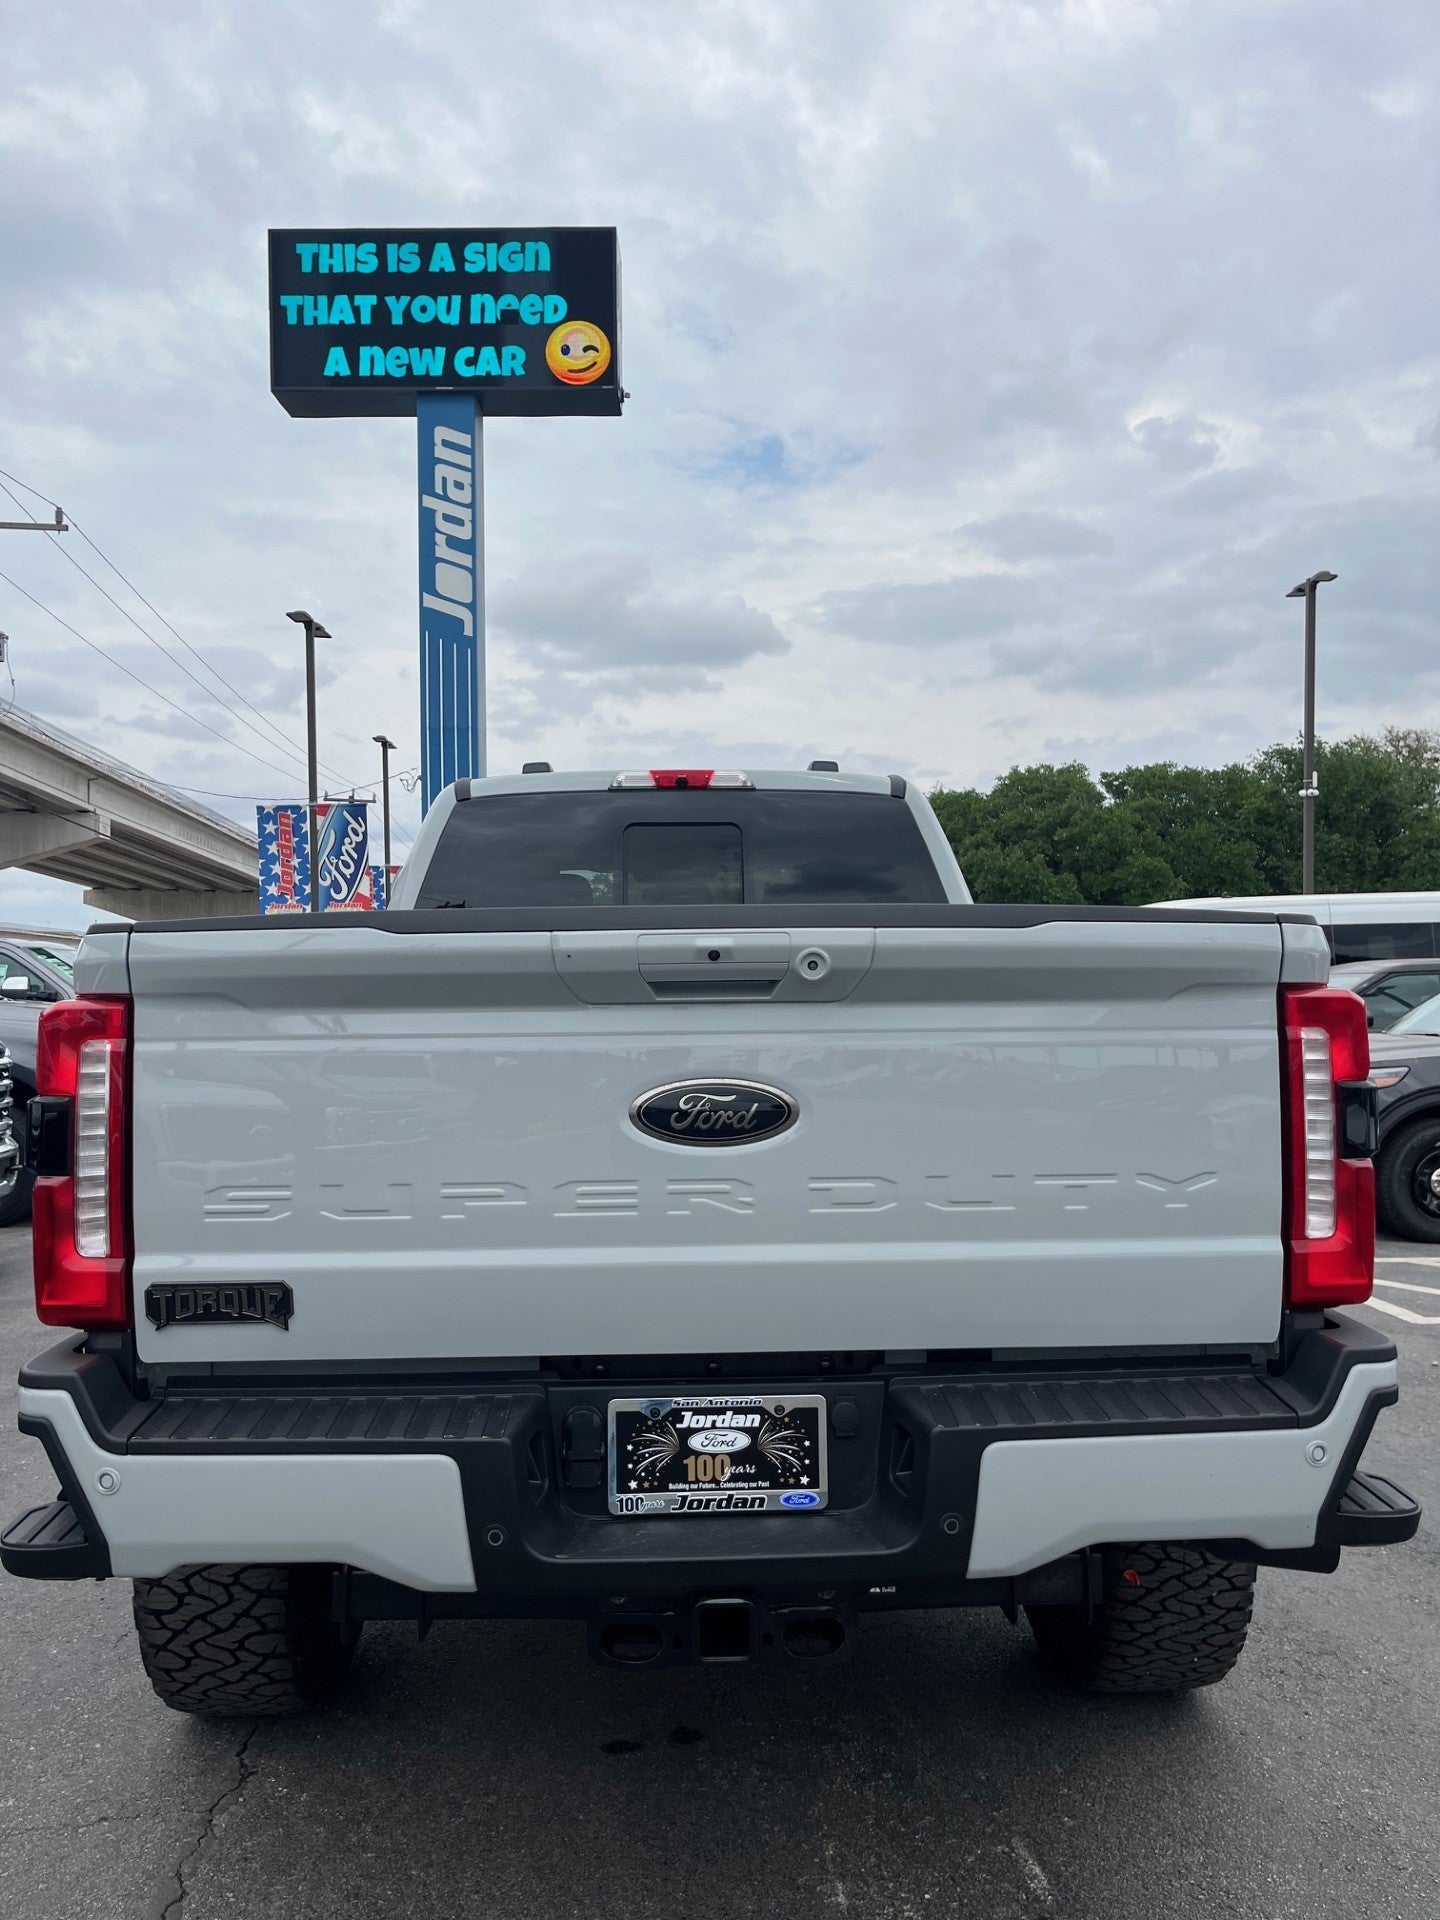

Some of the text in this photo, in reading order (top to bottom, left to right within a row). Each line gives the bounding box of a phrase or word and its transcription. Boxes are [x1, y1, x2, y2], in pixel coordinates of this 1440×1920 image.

[296, 242, 378, 274] THIS
[387, 242, 421, 274] IS
[428, 242, 456, 273] A
[280, 294, 377, 326] THAT
[384, 294, 461, 325] YOU
[323, 346, 351, 377] A
[453, 345, 526, 377] CAR
[422, 425, 474, 637] Jordan
[276, 811, 295, 900] Jordan
[319, 809, 366, 901] Ford
[670, 1093, 759, 1130] Ford
[203, 1172, 1218, 1222] SUPER DUTY
[151, 1285, 289, 1331] TORQUE
[672, 1398, 763, 1407] San Antonio
[676, 1410, 761, 1428] Jordan
[700, 1432, 737, 1448] Ford
[683, 1454, 757, 1482] 100 years
[720, 1481, 748, 1489] Celebrating
[788, 1495, 810, 1505] Ford
[616, 1495, 645, 1514] 100
[671, 1493, 767, 1512] Jordan
